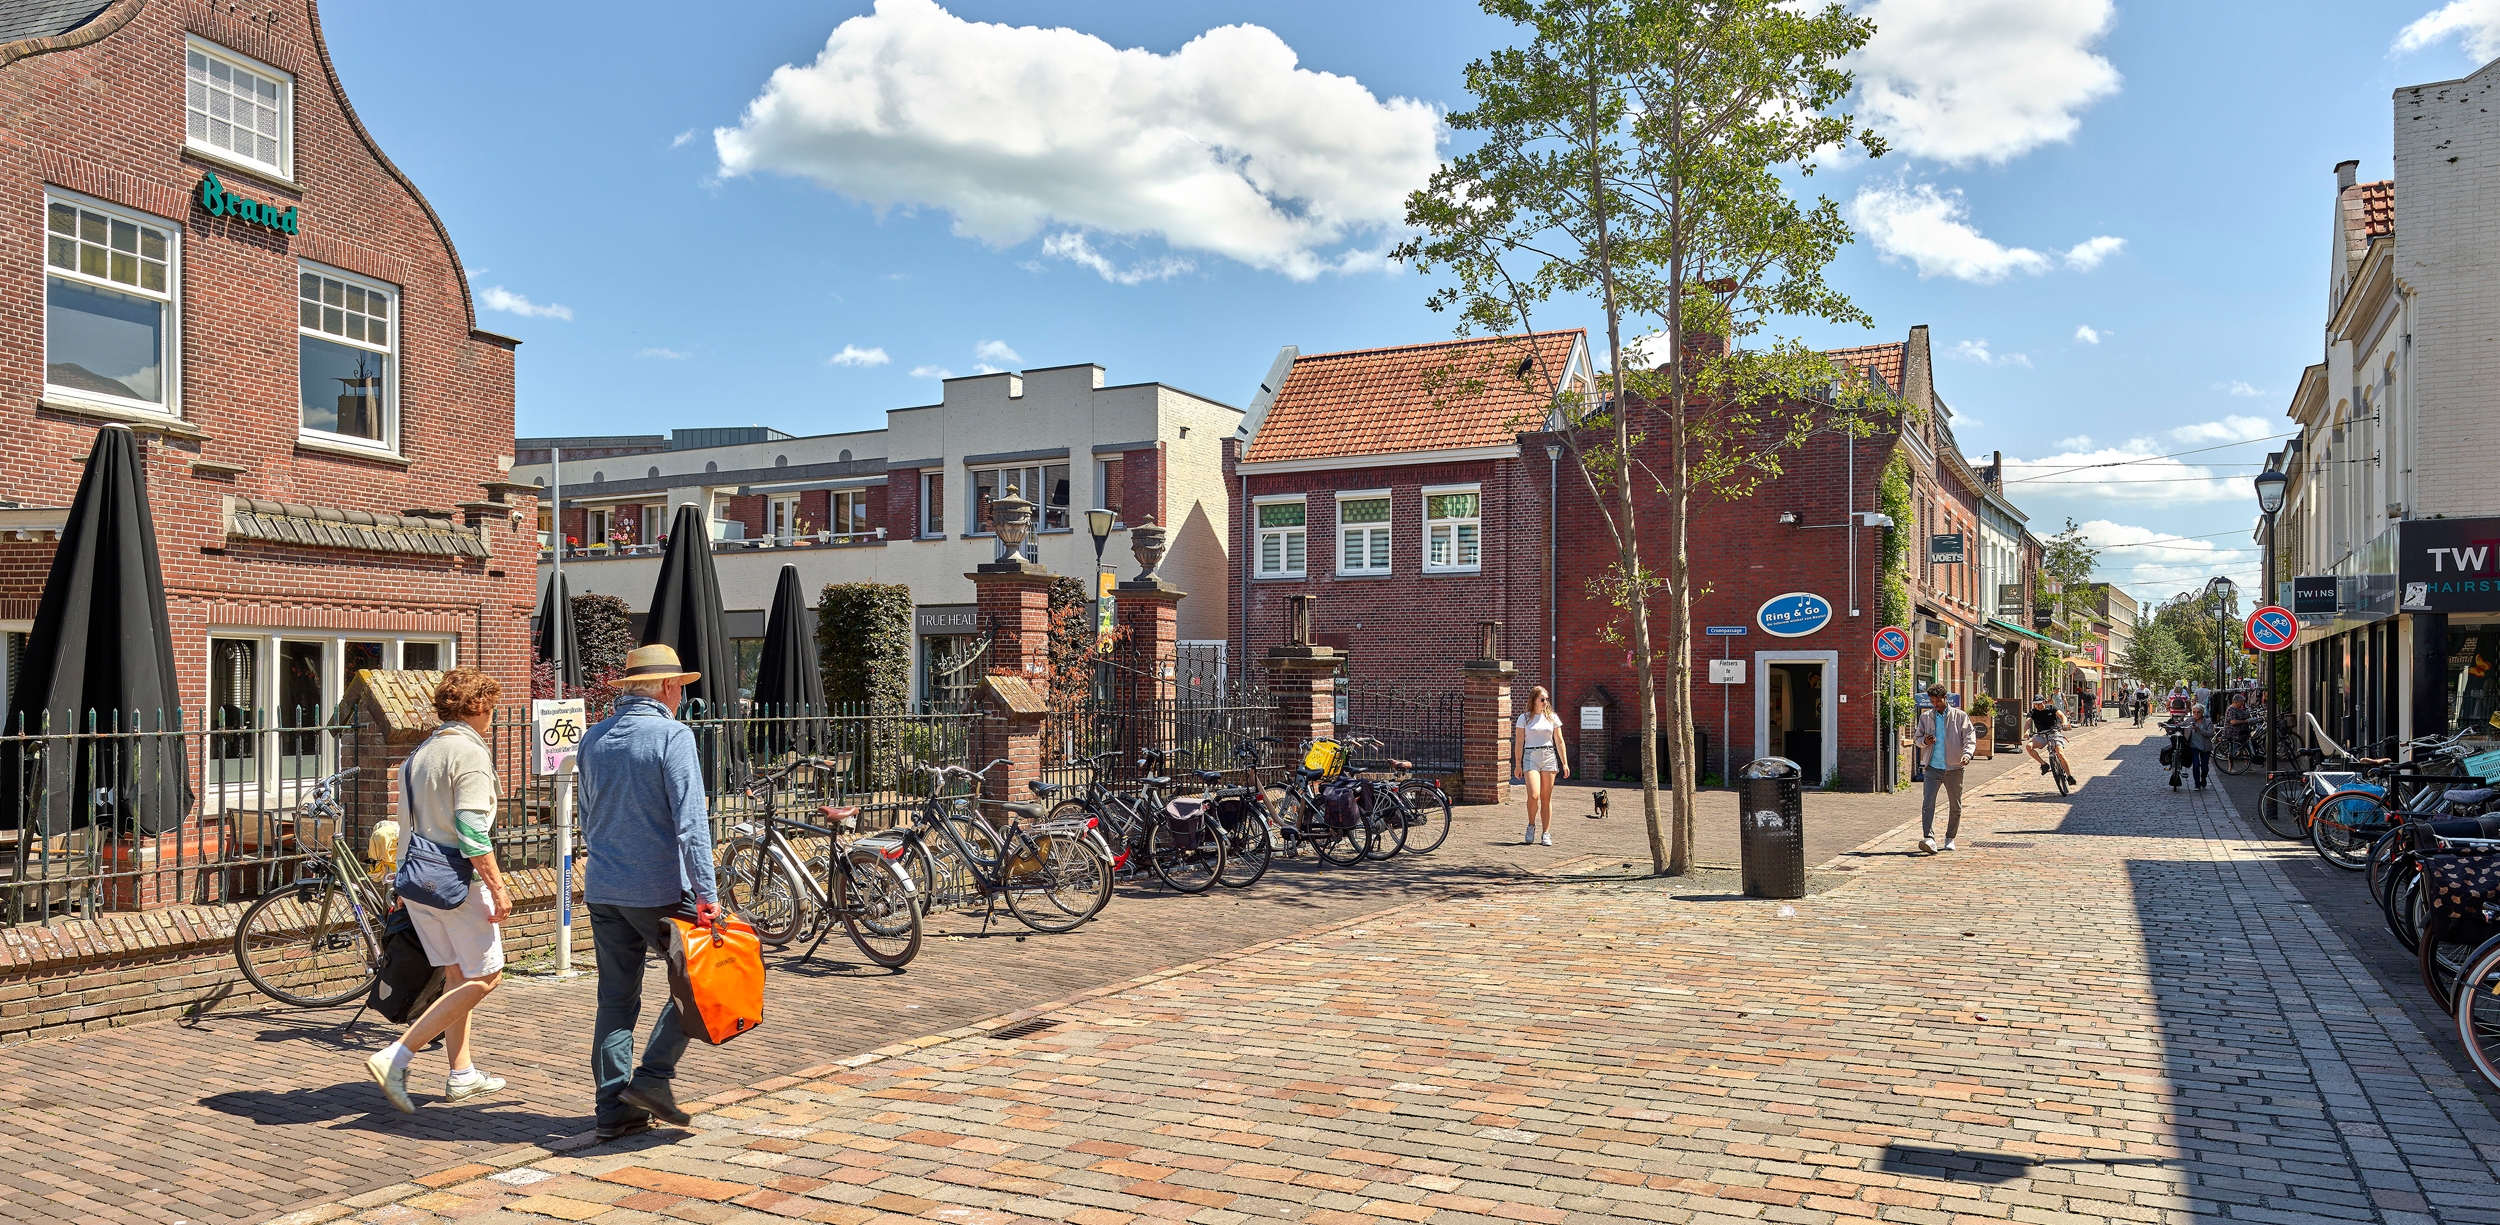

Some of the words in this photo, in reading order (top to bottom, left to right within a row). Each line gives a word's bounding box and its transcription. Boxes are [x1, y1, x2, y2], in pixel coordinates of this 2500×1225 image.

[202, 171, 299, 235] Brand
[1932, 553, 1963, 562] VOETS
[2427, 546, 2500, 572] TW
[2296, 589, 2335, 598] TWINS
[920, 614, 946, 626] TRUE
[1765, 612, 1790, 622] Ring
[1793, 609, 1801, 617] &
[1804, 606, 1820, 615] Go
